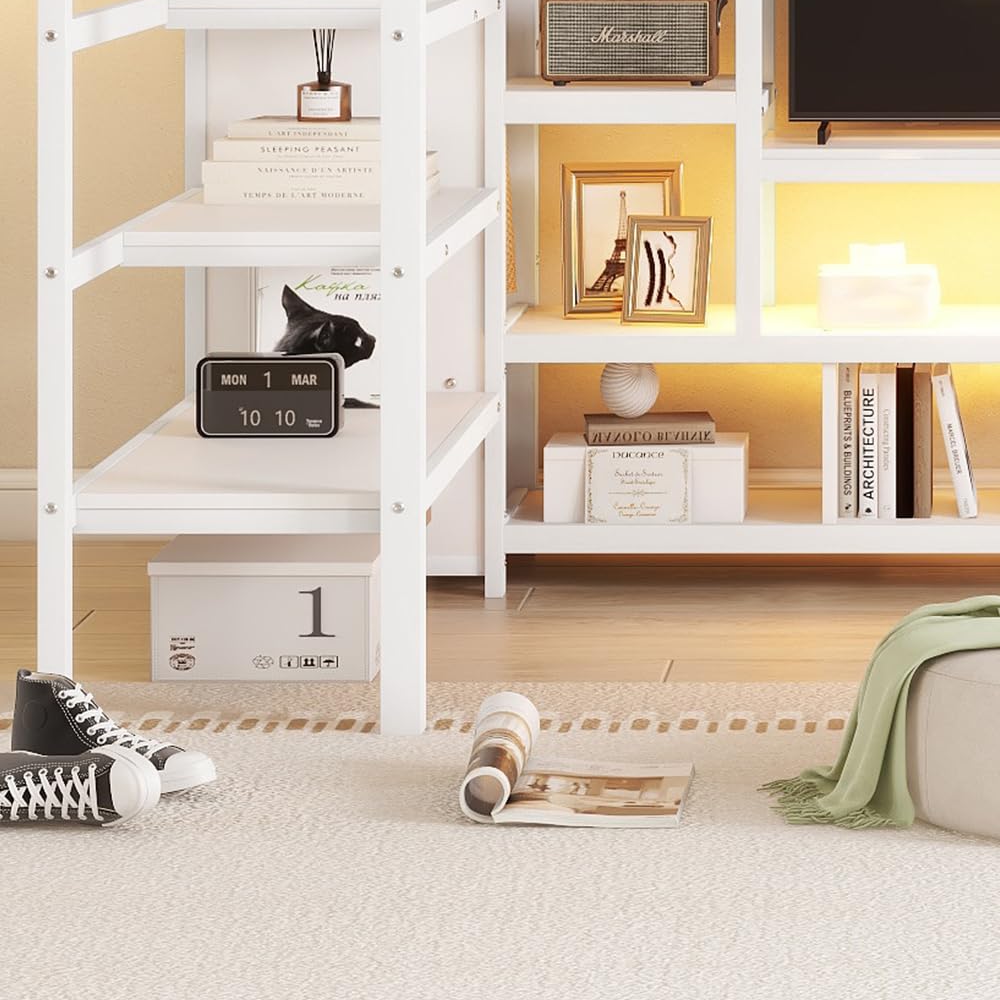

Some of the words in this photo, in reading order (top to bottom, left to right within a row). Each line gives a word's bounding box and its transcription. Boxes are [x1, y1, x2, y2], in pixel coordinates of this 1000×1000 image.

[591, 25, 668, 44] Marshall
[221, 374, 247, 386] MON
[263, 371, 271, 388] 1
[291, 374, 318, 386] MAR
[241, 410, 261, 427] 10
[275, 410, 296, 427] 10
[843, 390, 852, 442] BLUEPRINTS
[862, 388, 875, 500] ARCHITECTURE
[843, 451, 852, 496] BUILDINGS
[298, 586, 336, 638] 1
